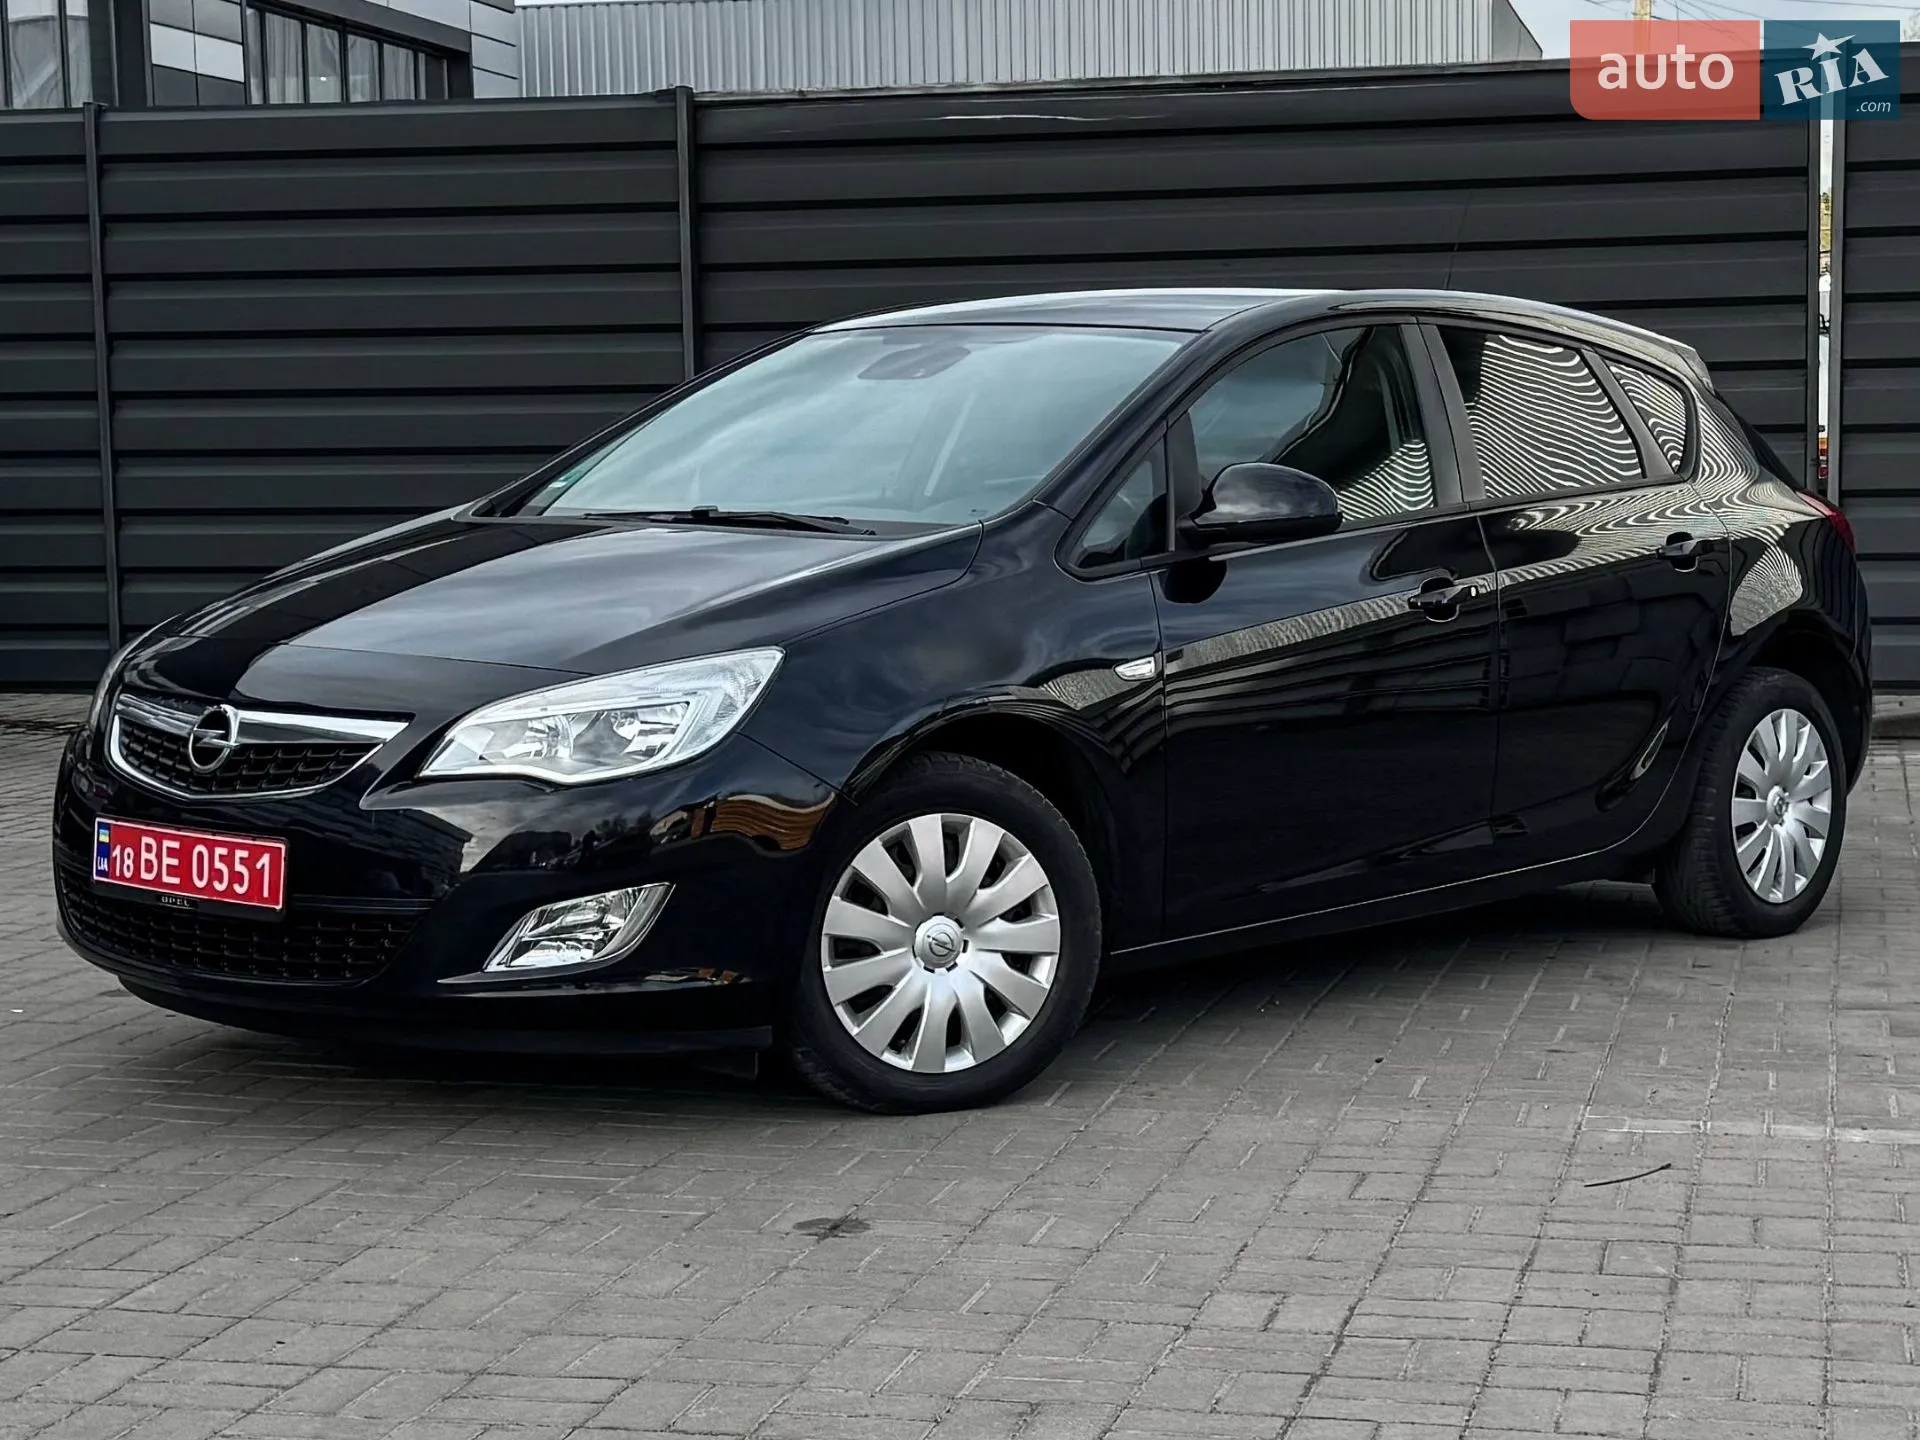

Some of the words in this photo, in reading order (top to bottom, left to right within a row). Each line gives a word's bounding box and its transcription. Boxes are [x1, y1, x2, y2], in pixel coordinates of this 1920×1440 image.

[97, 856, 109, 872] UA
[112, 844, 135, 879] 18
[140, 836, 181, 885] BE
[191, 844, 271, 898] 0551
